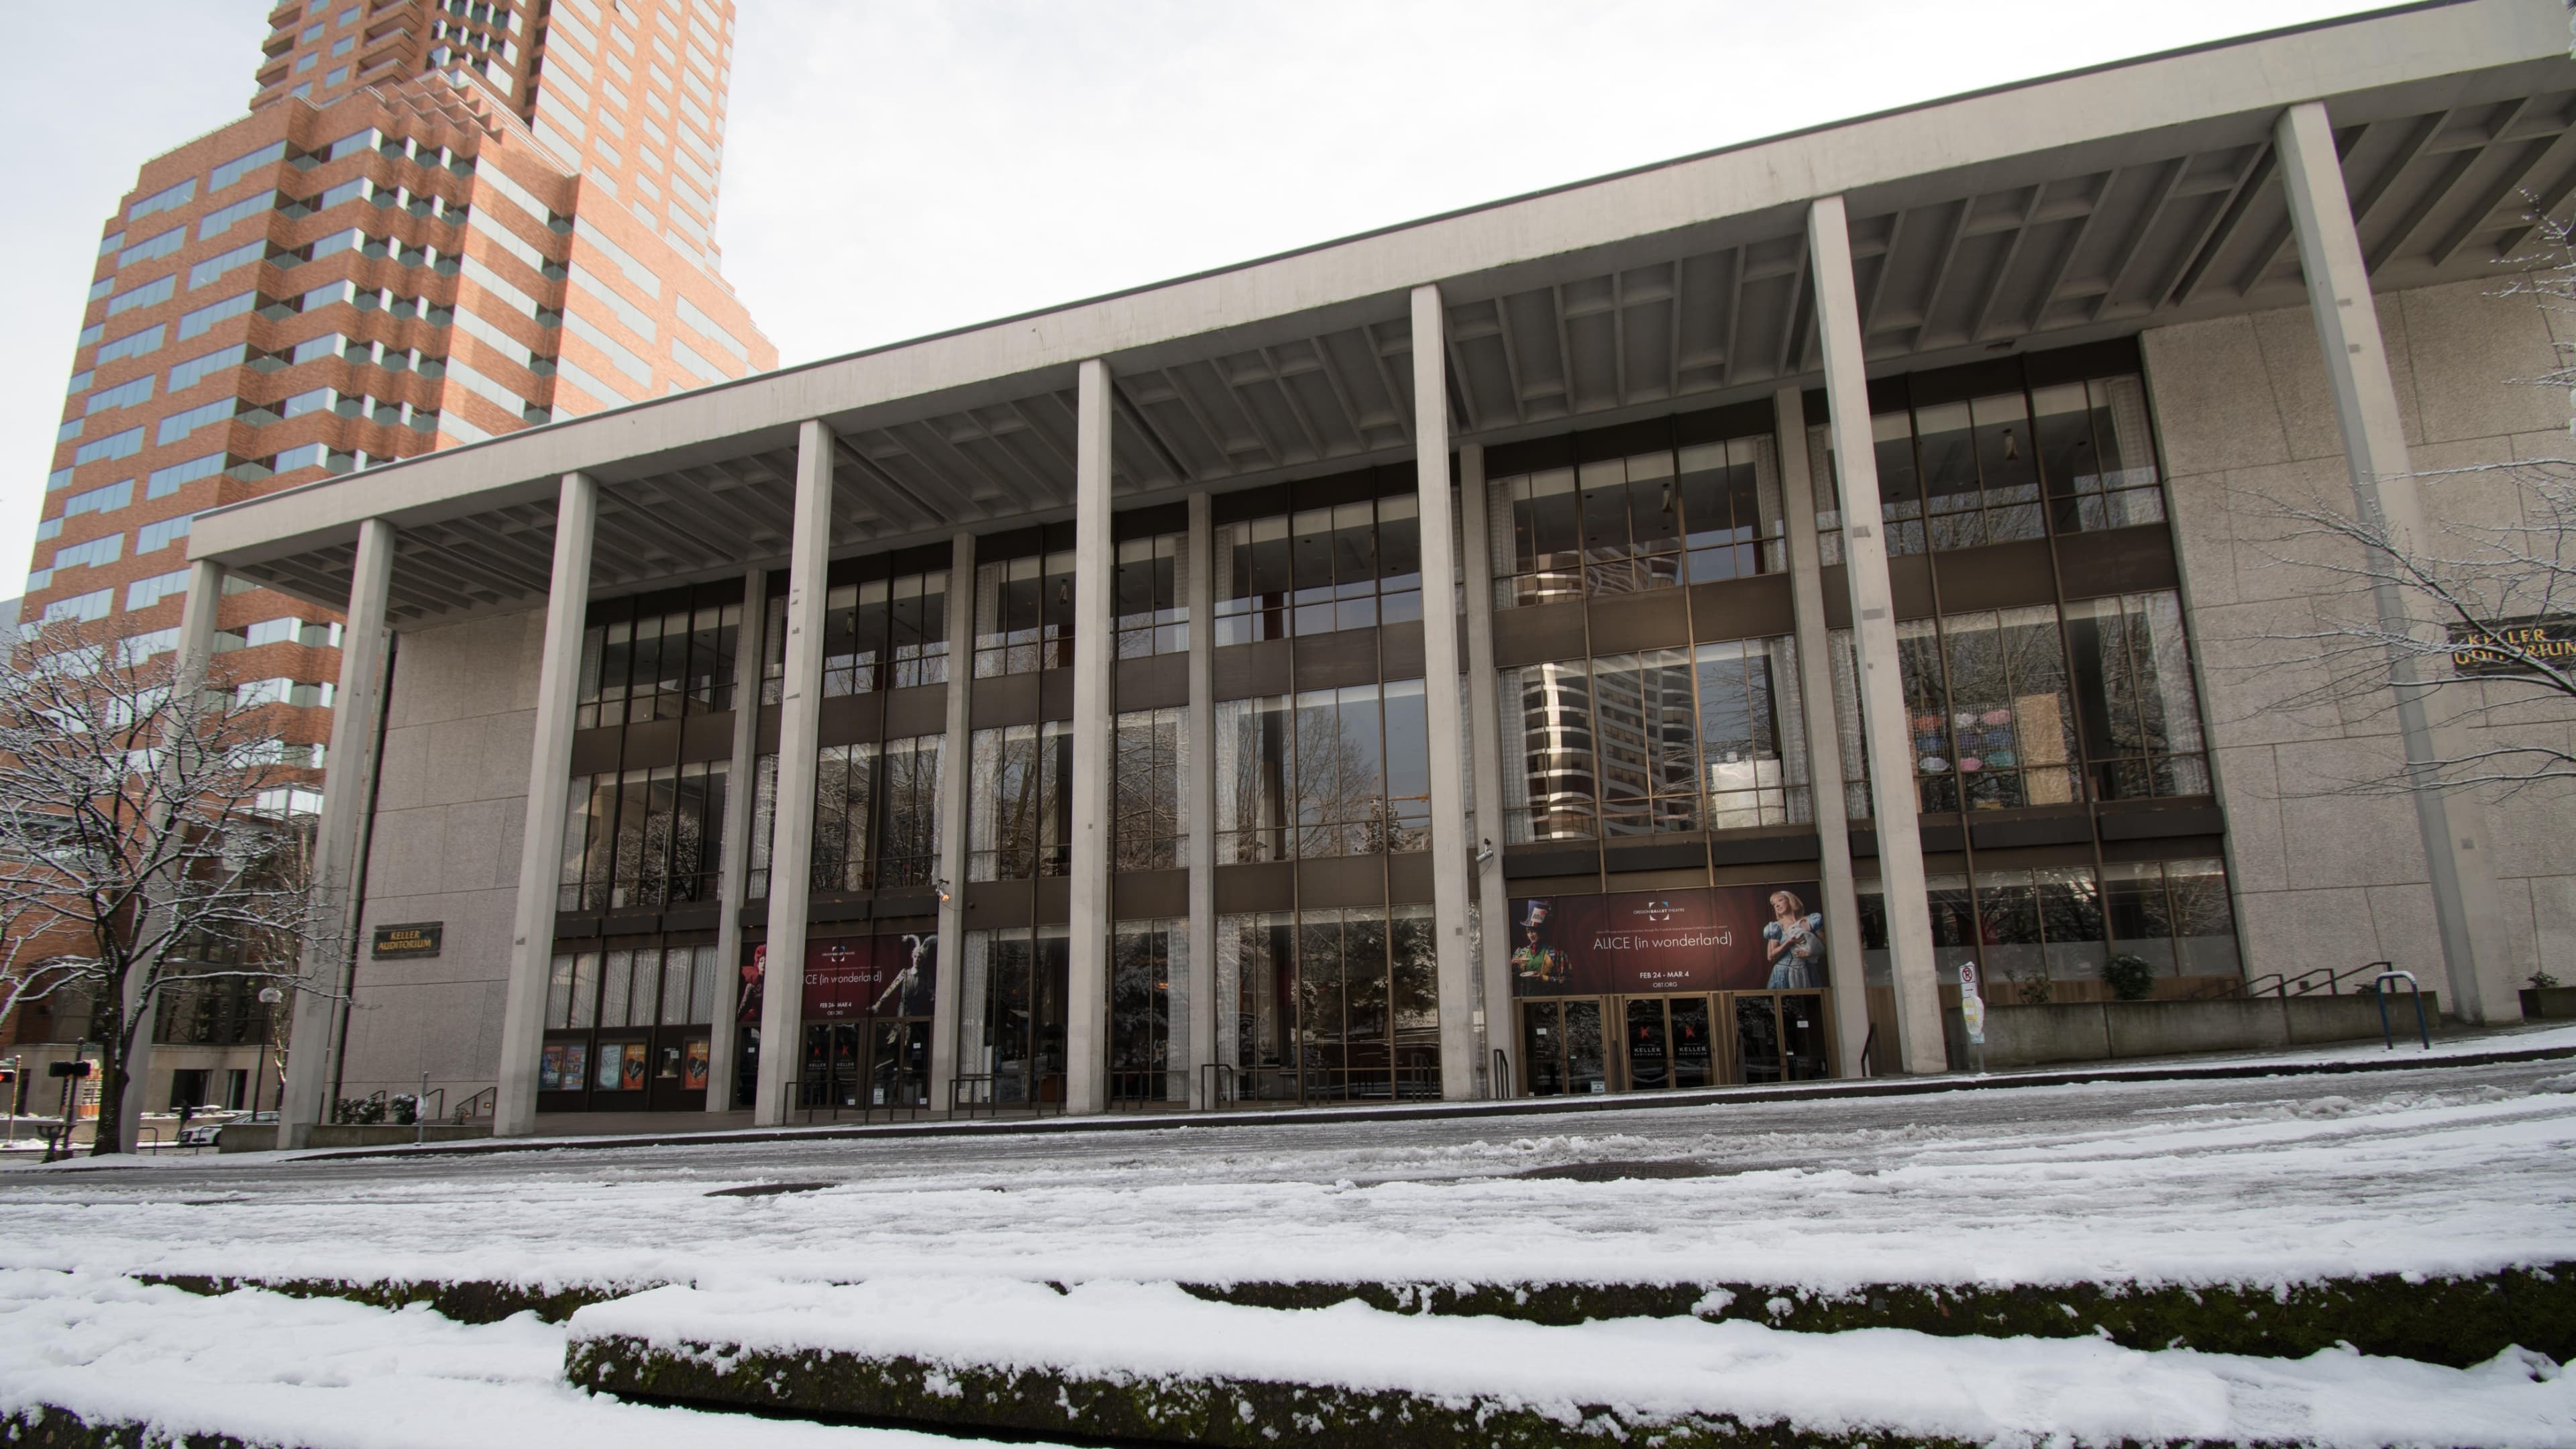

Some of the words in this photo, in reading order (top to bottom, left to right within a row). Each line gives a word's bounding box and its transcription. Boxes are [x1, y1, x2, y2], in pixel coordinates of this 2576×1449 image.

[390, 930, 419, 940] KELLER
[377, 939, 431, 950] AUDITORIUM
[1593, 936, 1630, 950] ALICE
[1635, 935, 1648, 951] (in
[1652, 931, 1732, 947] wonderland)
[820, 973, 829, 985] (in
